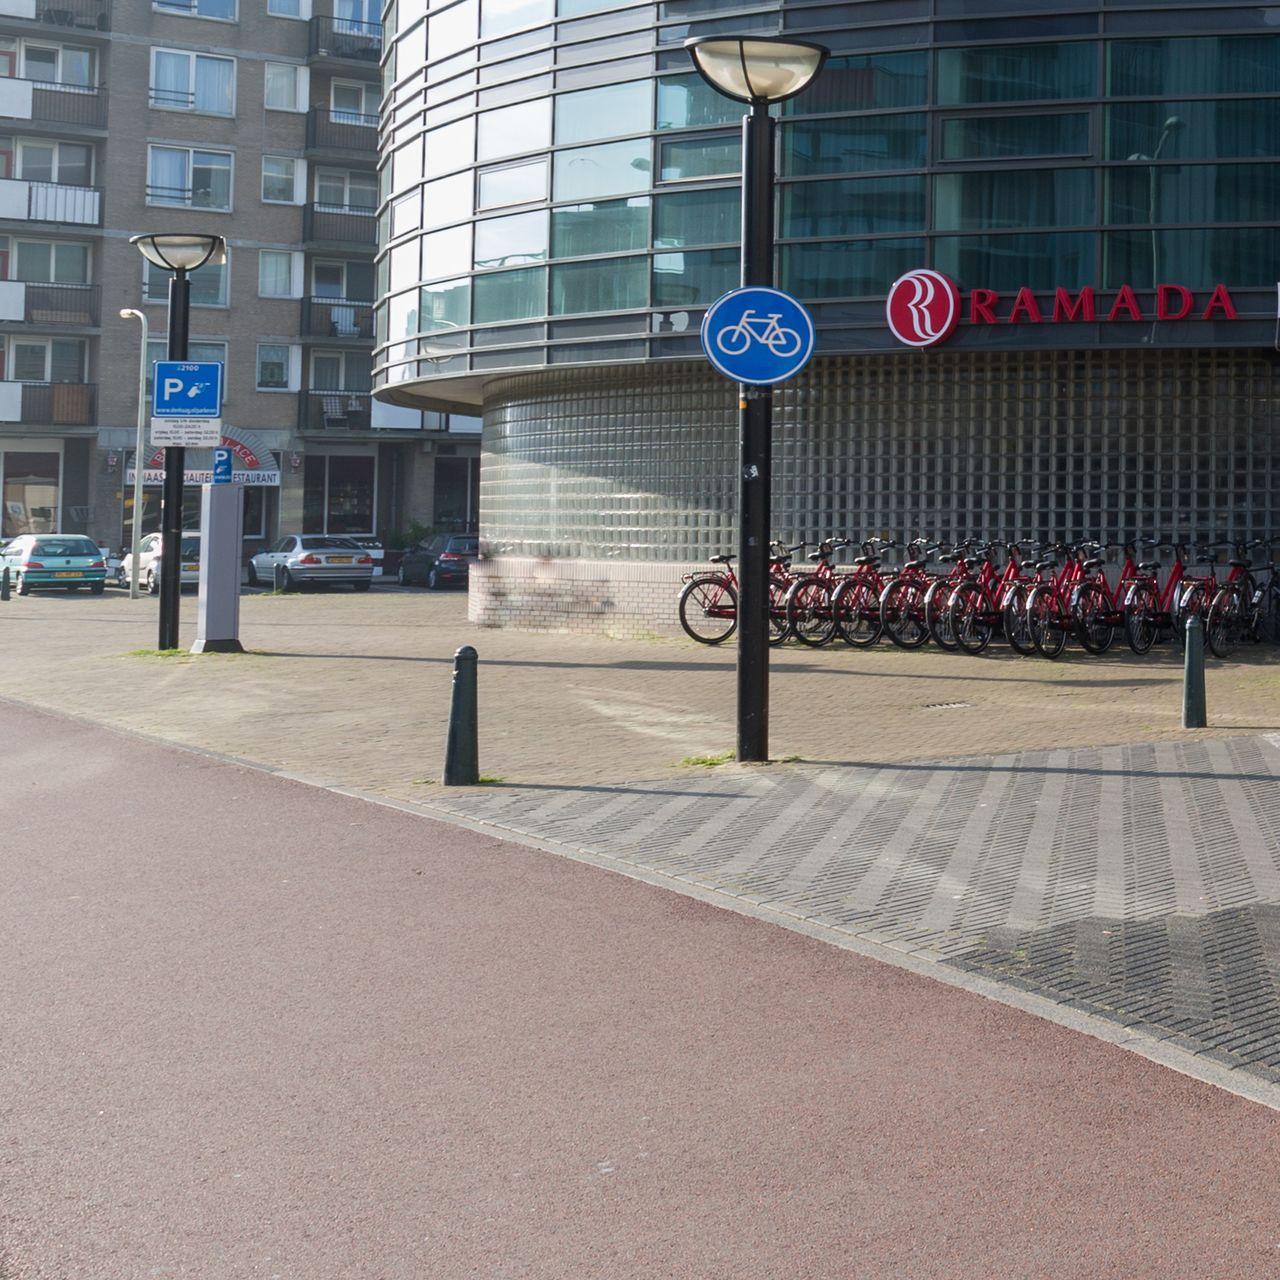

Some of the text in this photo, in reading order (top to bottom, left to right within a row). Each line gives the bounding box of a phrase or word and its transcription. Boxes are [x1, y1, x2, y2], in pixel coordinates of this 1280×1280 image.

[969, 283, 1237, 324] RAMADA
[164, 378, 183, 401] P
[215, 450, 228, 464] P
[128, 472, 163, 483] INIAAS
[233, 472, 277, 483] ESTAURANT
